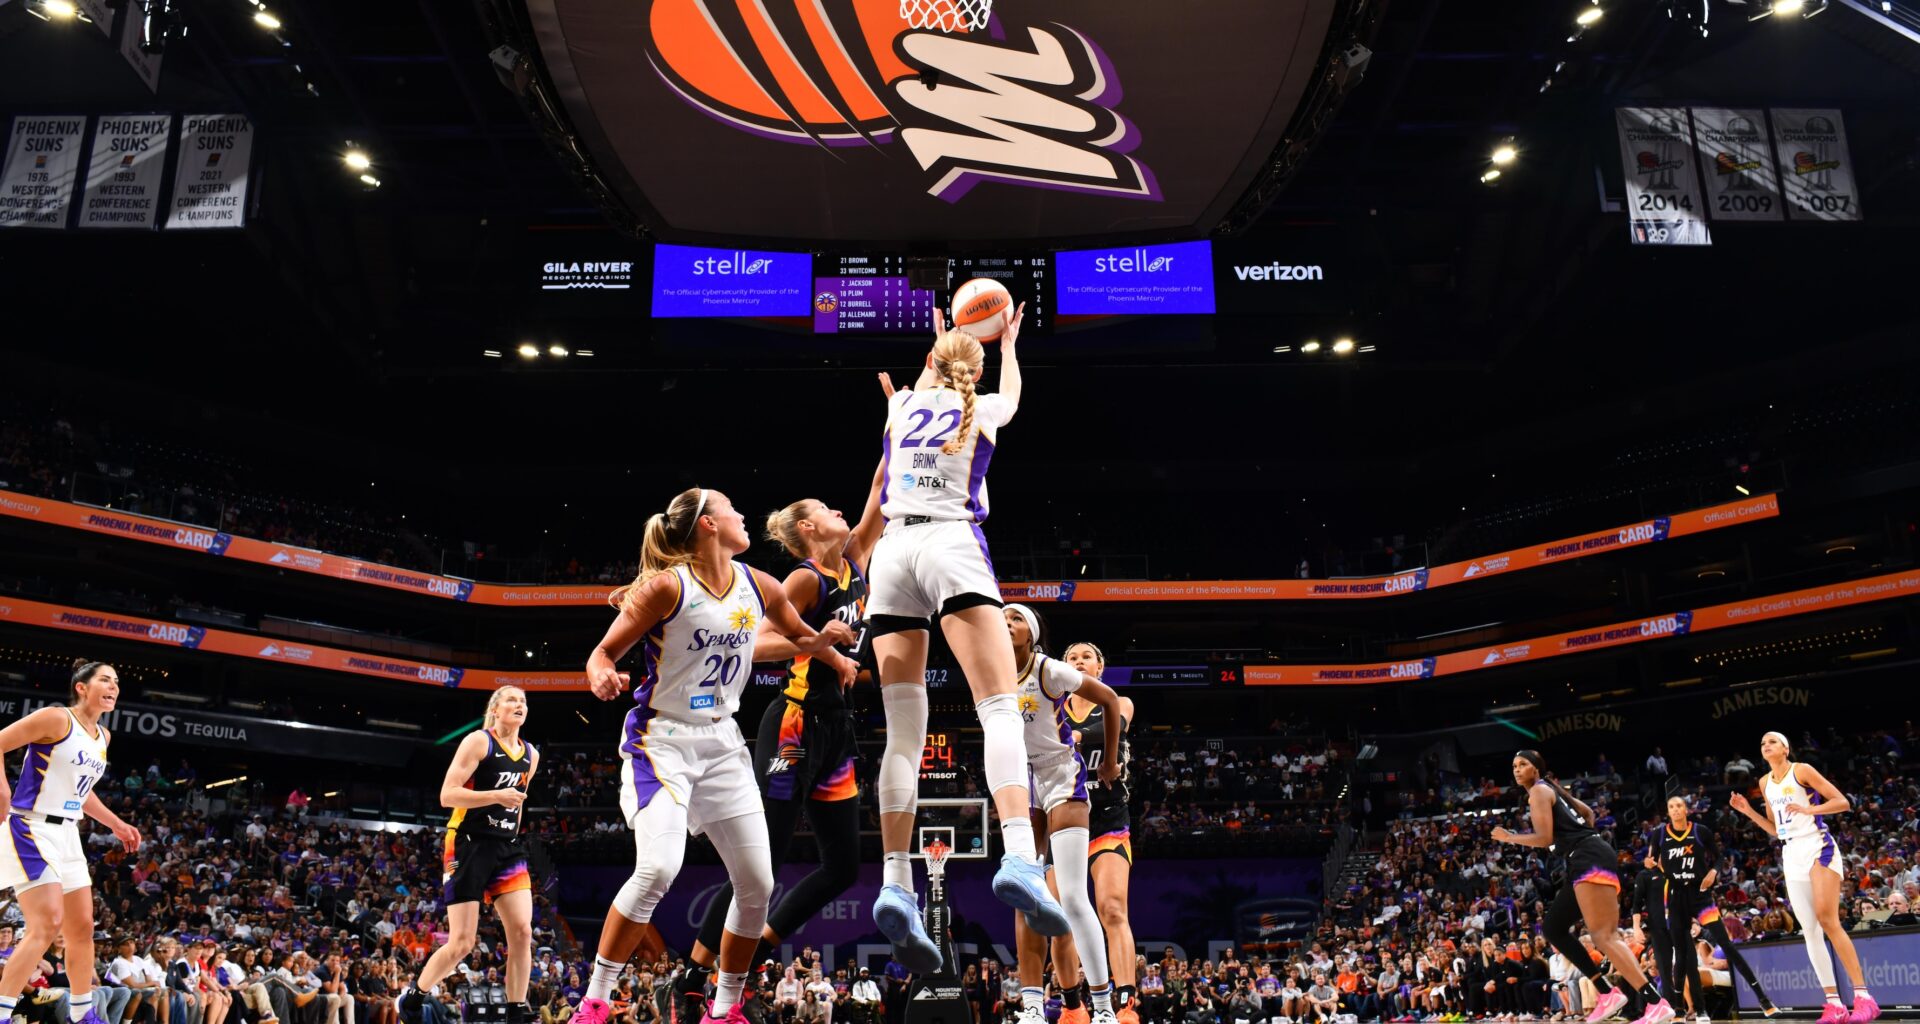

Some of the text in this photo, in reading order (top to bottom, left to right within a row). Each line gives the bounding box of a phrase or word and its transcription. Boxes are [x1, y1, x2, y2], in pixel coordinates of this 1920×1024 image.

[16, 120, 81, 136] PHOENIX
[100, 120, 165, 134] PHOENIX
[188, 120, 250, 134] PHOENIX
[25, 138, 64, 152] SUNS
[110, 138, 150, 152] SUNS
[197, 136, 234, 150] SUNS
[1705, 135, 1760, 143] CHAMPIONS
[1783, 134, 1838, 142] CHAMPIONS
[27, 172, 49, 182] 1976
[114, 172, 136, 182] 1993
[200, 170, 222, 180] 2021
[12, 185, 58, 195] WESTERN
[100, 186, 146, 195] WESTERN
[187, 184, 232, 194] WESTERN
[88, 198, 151, 209] CONFERENCE
[176, 196, 238, 207] CONFERENCE
[1638, 194, 1693, 212] 2014
[1718, 196, 1772, 212] 2009
[88, 212, 146, 222] CHAMPIONS
[543, 262, 632, 273] GILA RIVER
[1234, 262, 1323, 281] verizon
[663, 288, 675, 296] The
[676, 288, 700, 296] Official
[702, 288, 748, 297] Cybersecurity
[749, 288, 778, 296] Provider
[1106, 286, 1152, 294] Cybersecurity
[1153, 285, 1181, 293] Provider
[731, 297, 760, 306] Mercury
[1136, 295, 1164, 304] Mercury
[900, 408, 962, 448] 22
[912, 453, 939, 469] BRINK
[917, 476, 949, 489] AT&T
[1704, 503, 1767, 524] Official Credit
[88, 514, 132, 530] PHOENIX
[132, 522, 177, 540] MERCURY
[174, 528, 214, 549] CARD
[1546, 524, 1655, 558] PHOENIX MERCURY CARD
[1483, 556, 1510, 566] MOUNTAIN
[1486, 562, 1508, 570] AMERICA
[358, 567, 459, 596] PHOENIX MERCURY CARD
[1314, 576, 1416, 594] PHOENIX MERCURY CARD
[502, 592, 530, 600] Official
[532, 592, 557, 600] Credit
[559, 592, 583, 600] Union
[1027, 585, 1061, 598] CARD
[1105, 586, 1276, 595] Official Credit Union of the Phoenix Mercury
[1727, 582, 1897, 619] Official Credit Union of the Phoenix
[61, 612, 105, 628] PHOENIX
[105, 619, 152, 634] MERCURY
[148, 624, 188, 642] CARD
[1567, 617, 1677, 647] PHOENIX MERCURY CARD
[687, 628, 752, 652] SPARKS
[348, 657, 384, 669] PHOENIX
[384, 662, 420, 676] MERCURY
[418, 666, 450, 682] CARD
[698, 654, 741, 688] 20
[1221, 671, 1236, 682] 24
[1250, 671, 1282, 680] Mercury
[1320, 663, 1423, 679] PHOENIX MERCURY CARD
[495, 677, 523, 685] Official
[524, 677, 549, 685] Credit
[551, 677, 575, 685] Union
[576, 677, 586, 685] of
[693, 698, 711, 707] UCLA
[1712, 686, 1809, 720] JAMESON
[184, 722, 247, 742] TEQUILA
[1537, 712, 1622, 742] JAMESON
[1210, 742, 1220, 750] 121
[921, 747, 952, 769] 24
[74, 774, 94, 797] 10
[494, 772, 529, 788] PHX
[1668, 844, 1694, 860] PHX
[1682, 857, 1695, 869] 14
[822, 900, 860, 920] BET
[933, 907, 941, 934] Health
